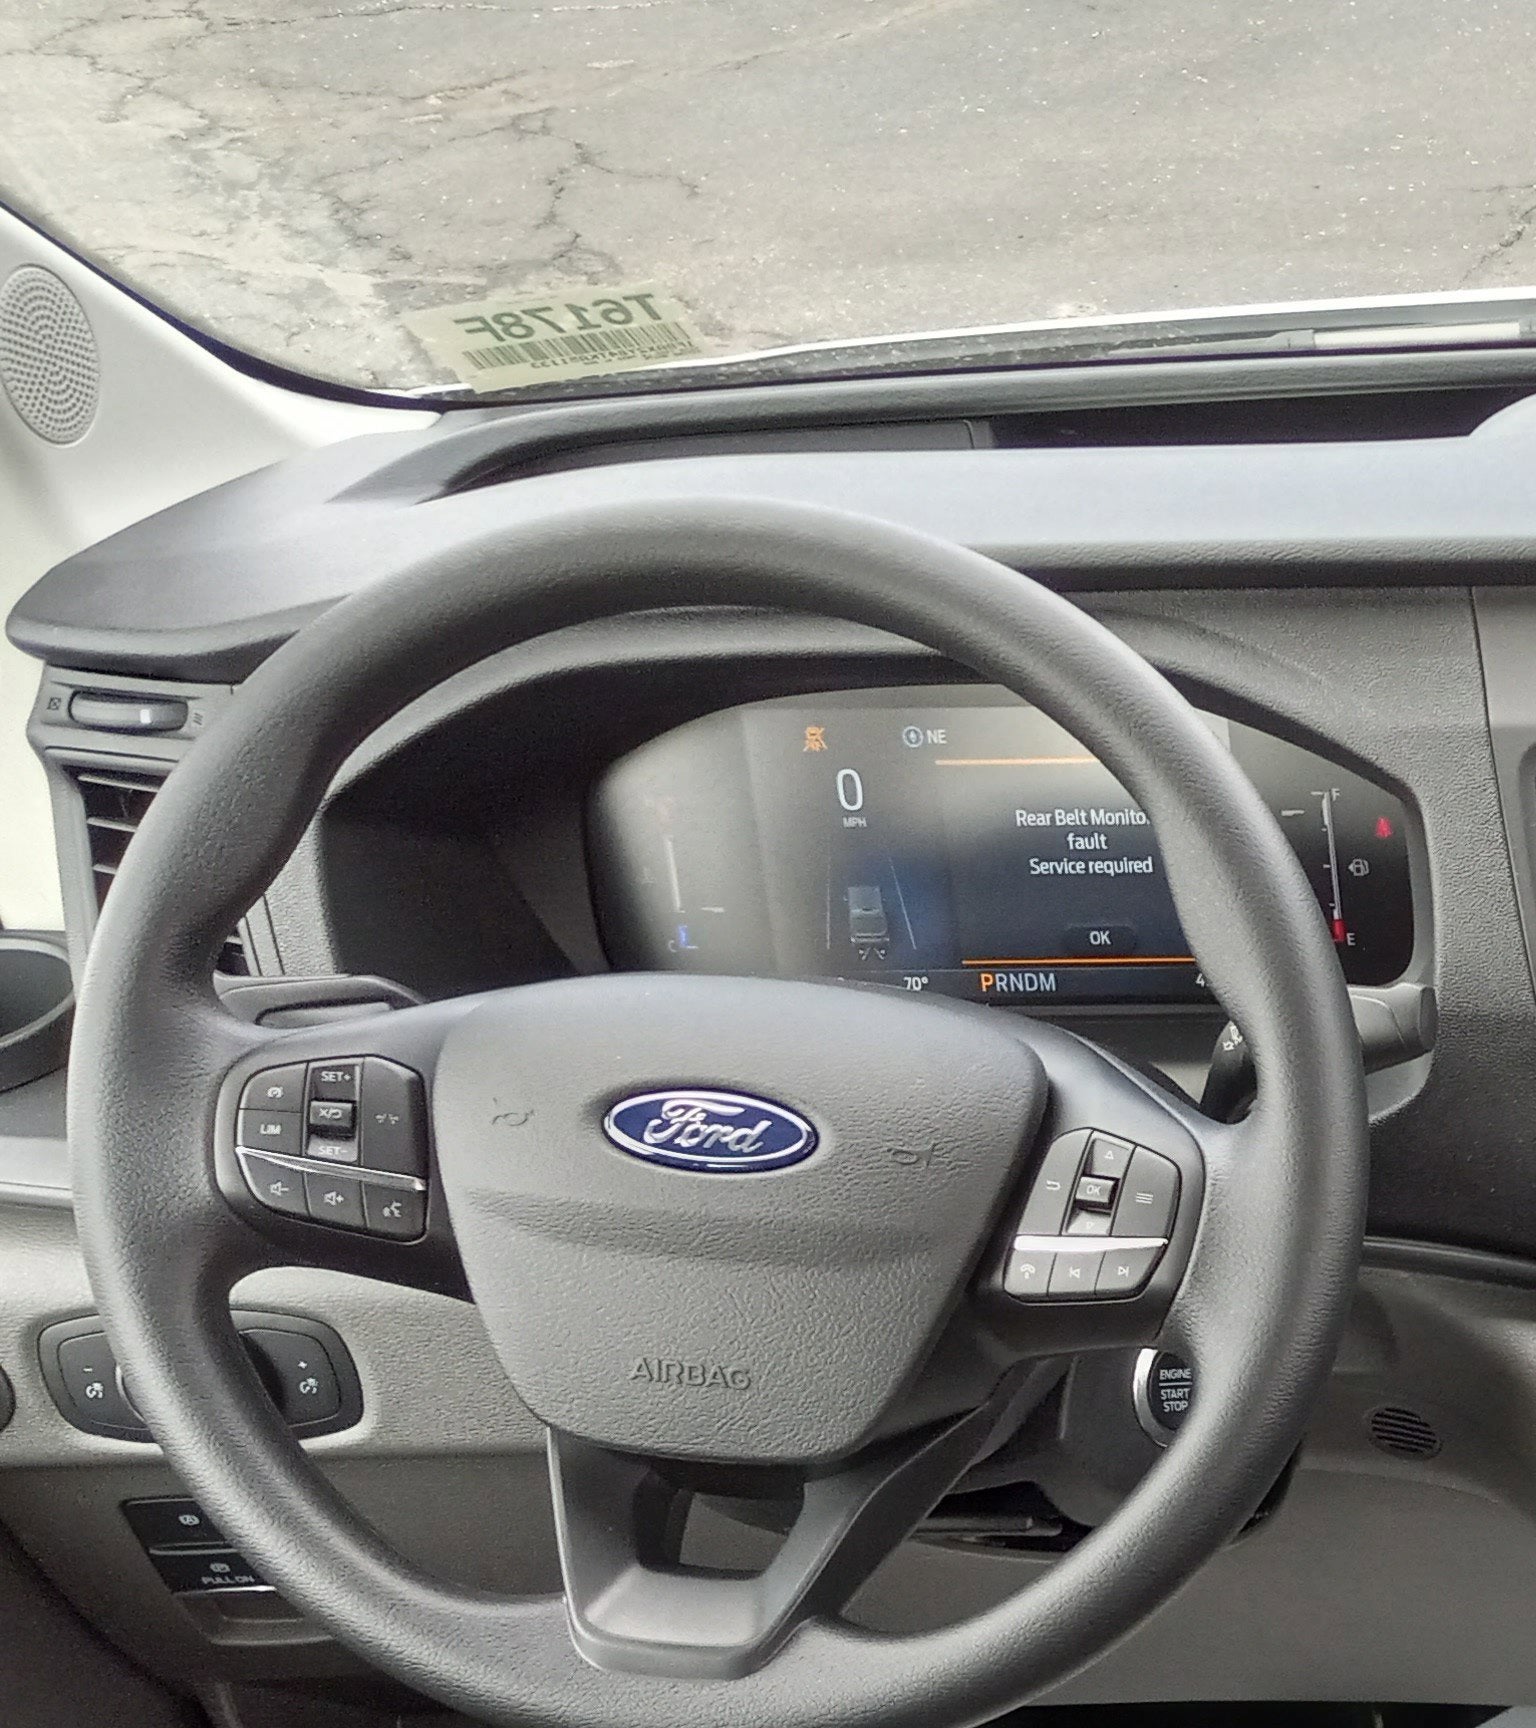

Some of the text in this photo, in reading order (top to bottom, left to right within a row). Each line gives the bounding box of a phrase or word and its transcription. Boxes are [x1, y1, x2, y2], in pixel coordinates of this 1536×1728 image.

[926, 729, 947, 744] NE
[835, 767, 864, 811] 0
[1331, 787, 1341, 801] F
[842, 816, 867, 828] MPH
[1015, 808, 1150, 826] Rear Belt Monito
[1066, 832, 1108, 850] fault
[1029, 856, 1154, 877] Service required
[1089, 930, 1111, 945] OK
[1346, 932, 1356, 946] E
[903, 976, 929, 992] 70°
[979, 972, 1057, 993] PRNDM
[260, 1123, 282, 1135] LIM
[643, 1098, 773, 1153] Ford
[1086, 1184, 1102, 1196] OK
[628, 1357, 751, 1390] AIRBAG
[1159, 1368, 1192, 1380] ENGINE
[1160, 1388, 1191, 1400] START
[1163, 1401, 1189, 1413] STOP
